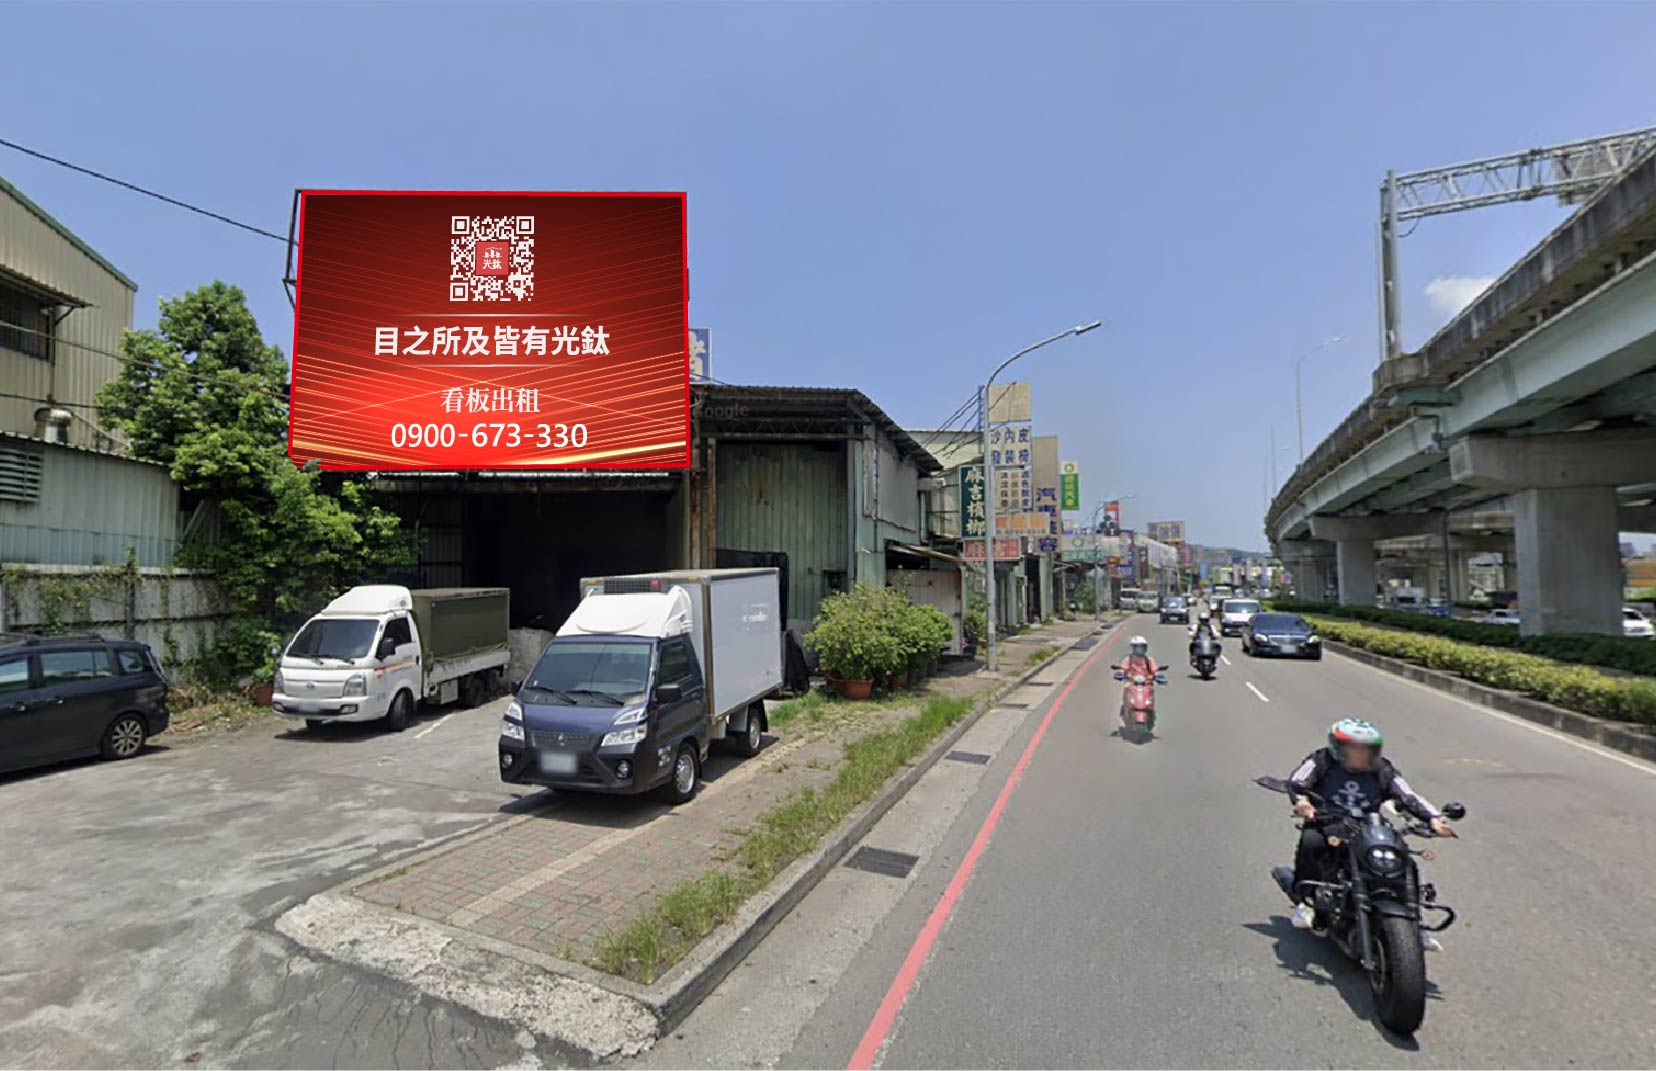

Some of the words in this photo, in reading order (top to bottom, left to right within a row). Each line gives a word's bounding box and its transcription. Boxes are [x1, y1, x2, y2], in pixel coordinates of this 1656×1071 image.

[482, 258, 503, 271] 光鈦
[374, 325, 610, 357] 目之所及皆有光鈦
[440, 387, 541, 414] 看板出租
[391, 422, 588, 448] 0900-673-330
